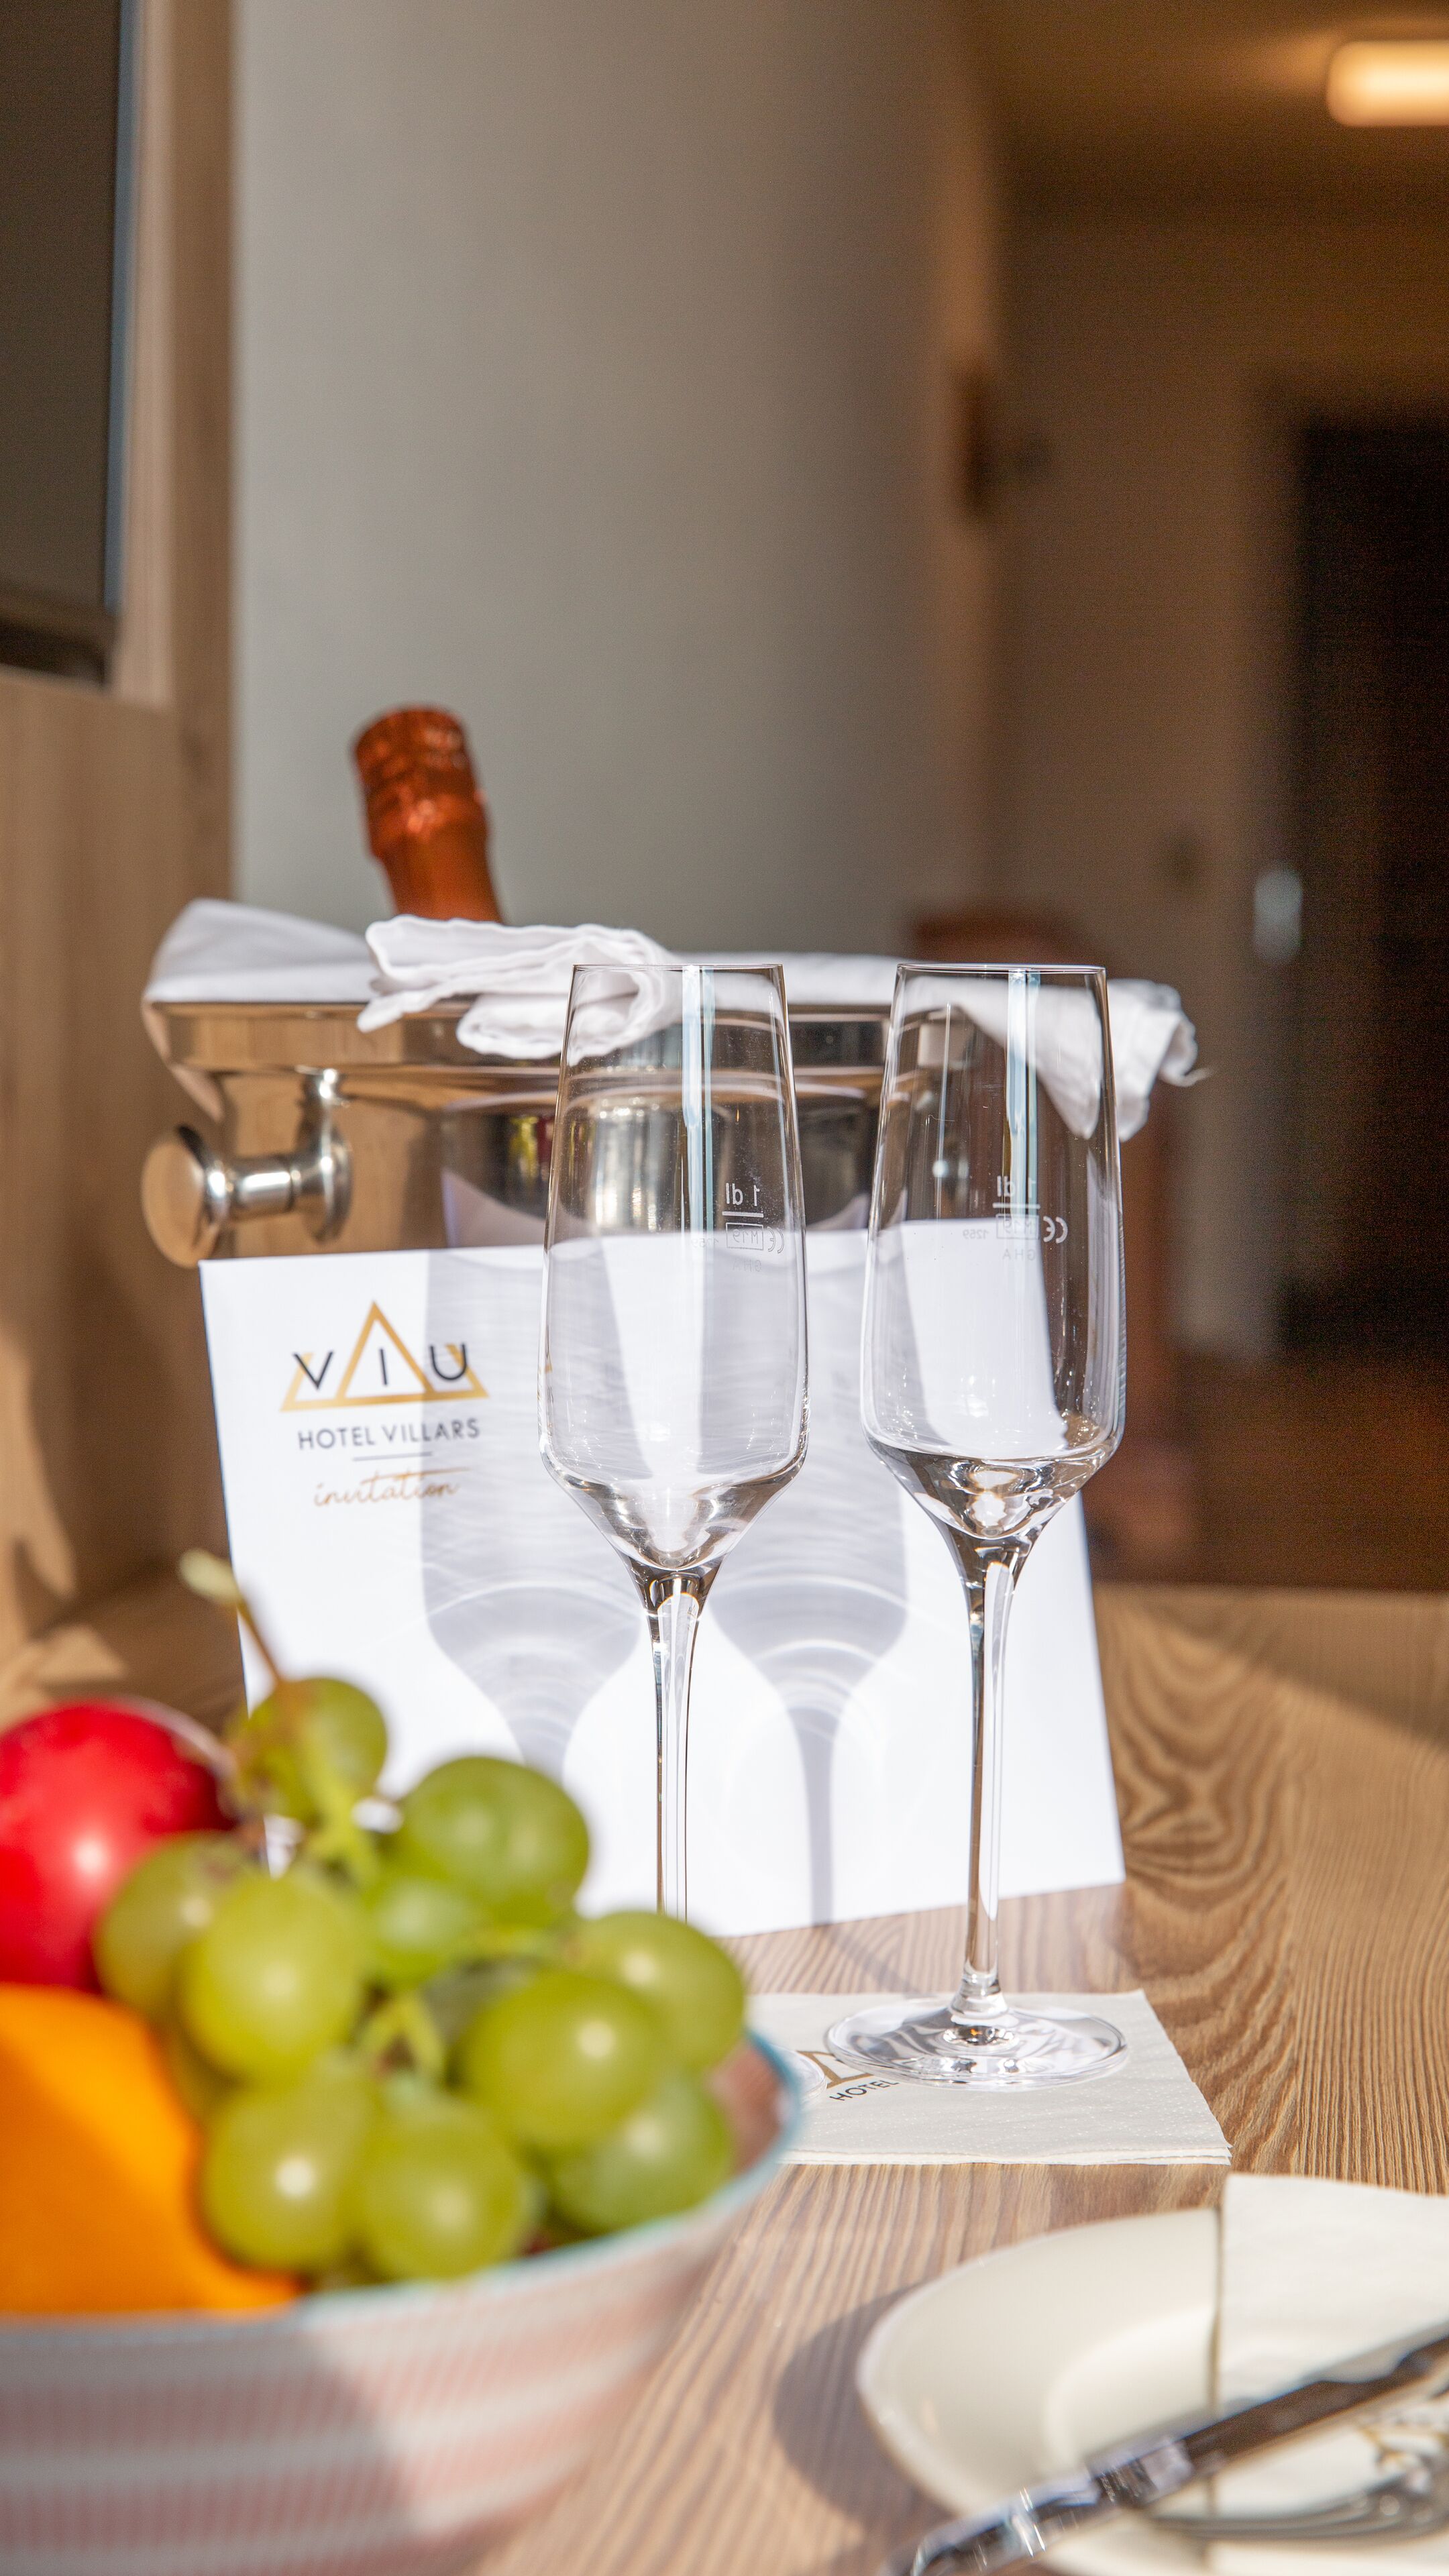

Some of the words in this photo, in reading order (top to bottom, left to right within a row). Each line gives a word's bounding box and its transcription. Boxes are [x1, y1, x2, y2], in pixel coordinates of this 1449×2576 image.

[292, 1342, 468, 1390] VIU
[298, 1426, 376, 1450] HOTEL
[382, 1417, 480, 1444] VILLARS
[313, 1466, 474, 1507] invitation
[829, 2080, 900, 2101] HOTEL
